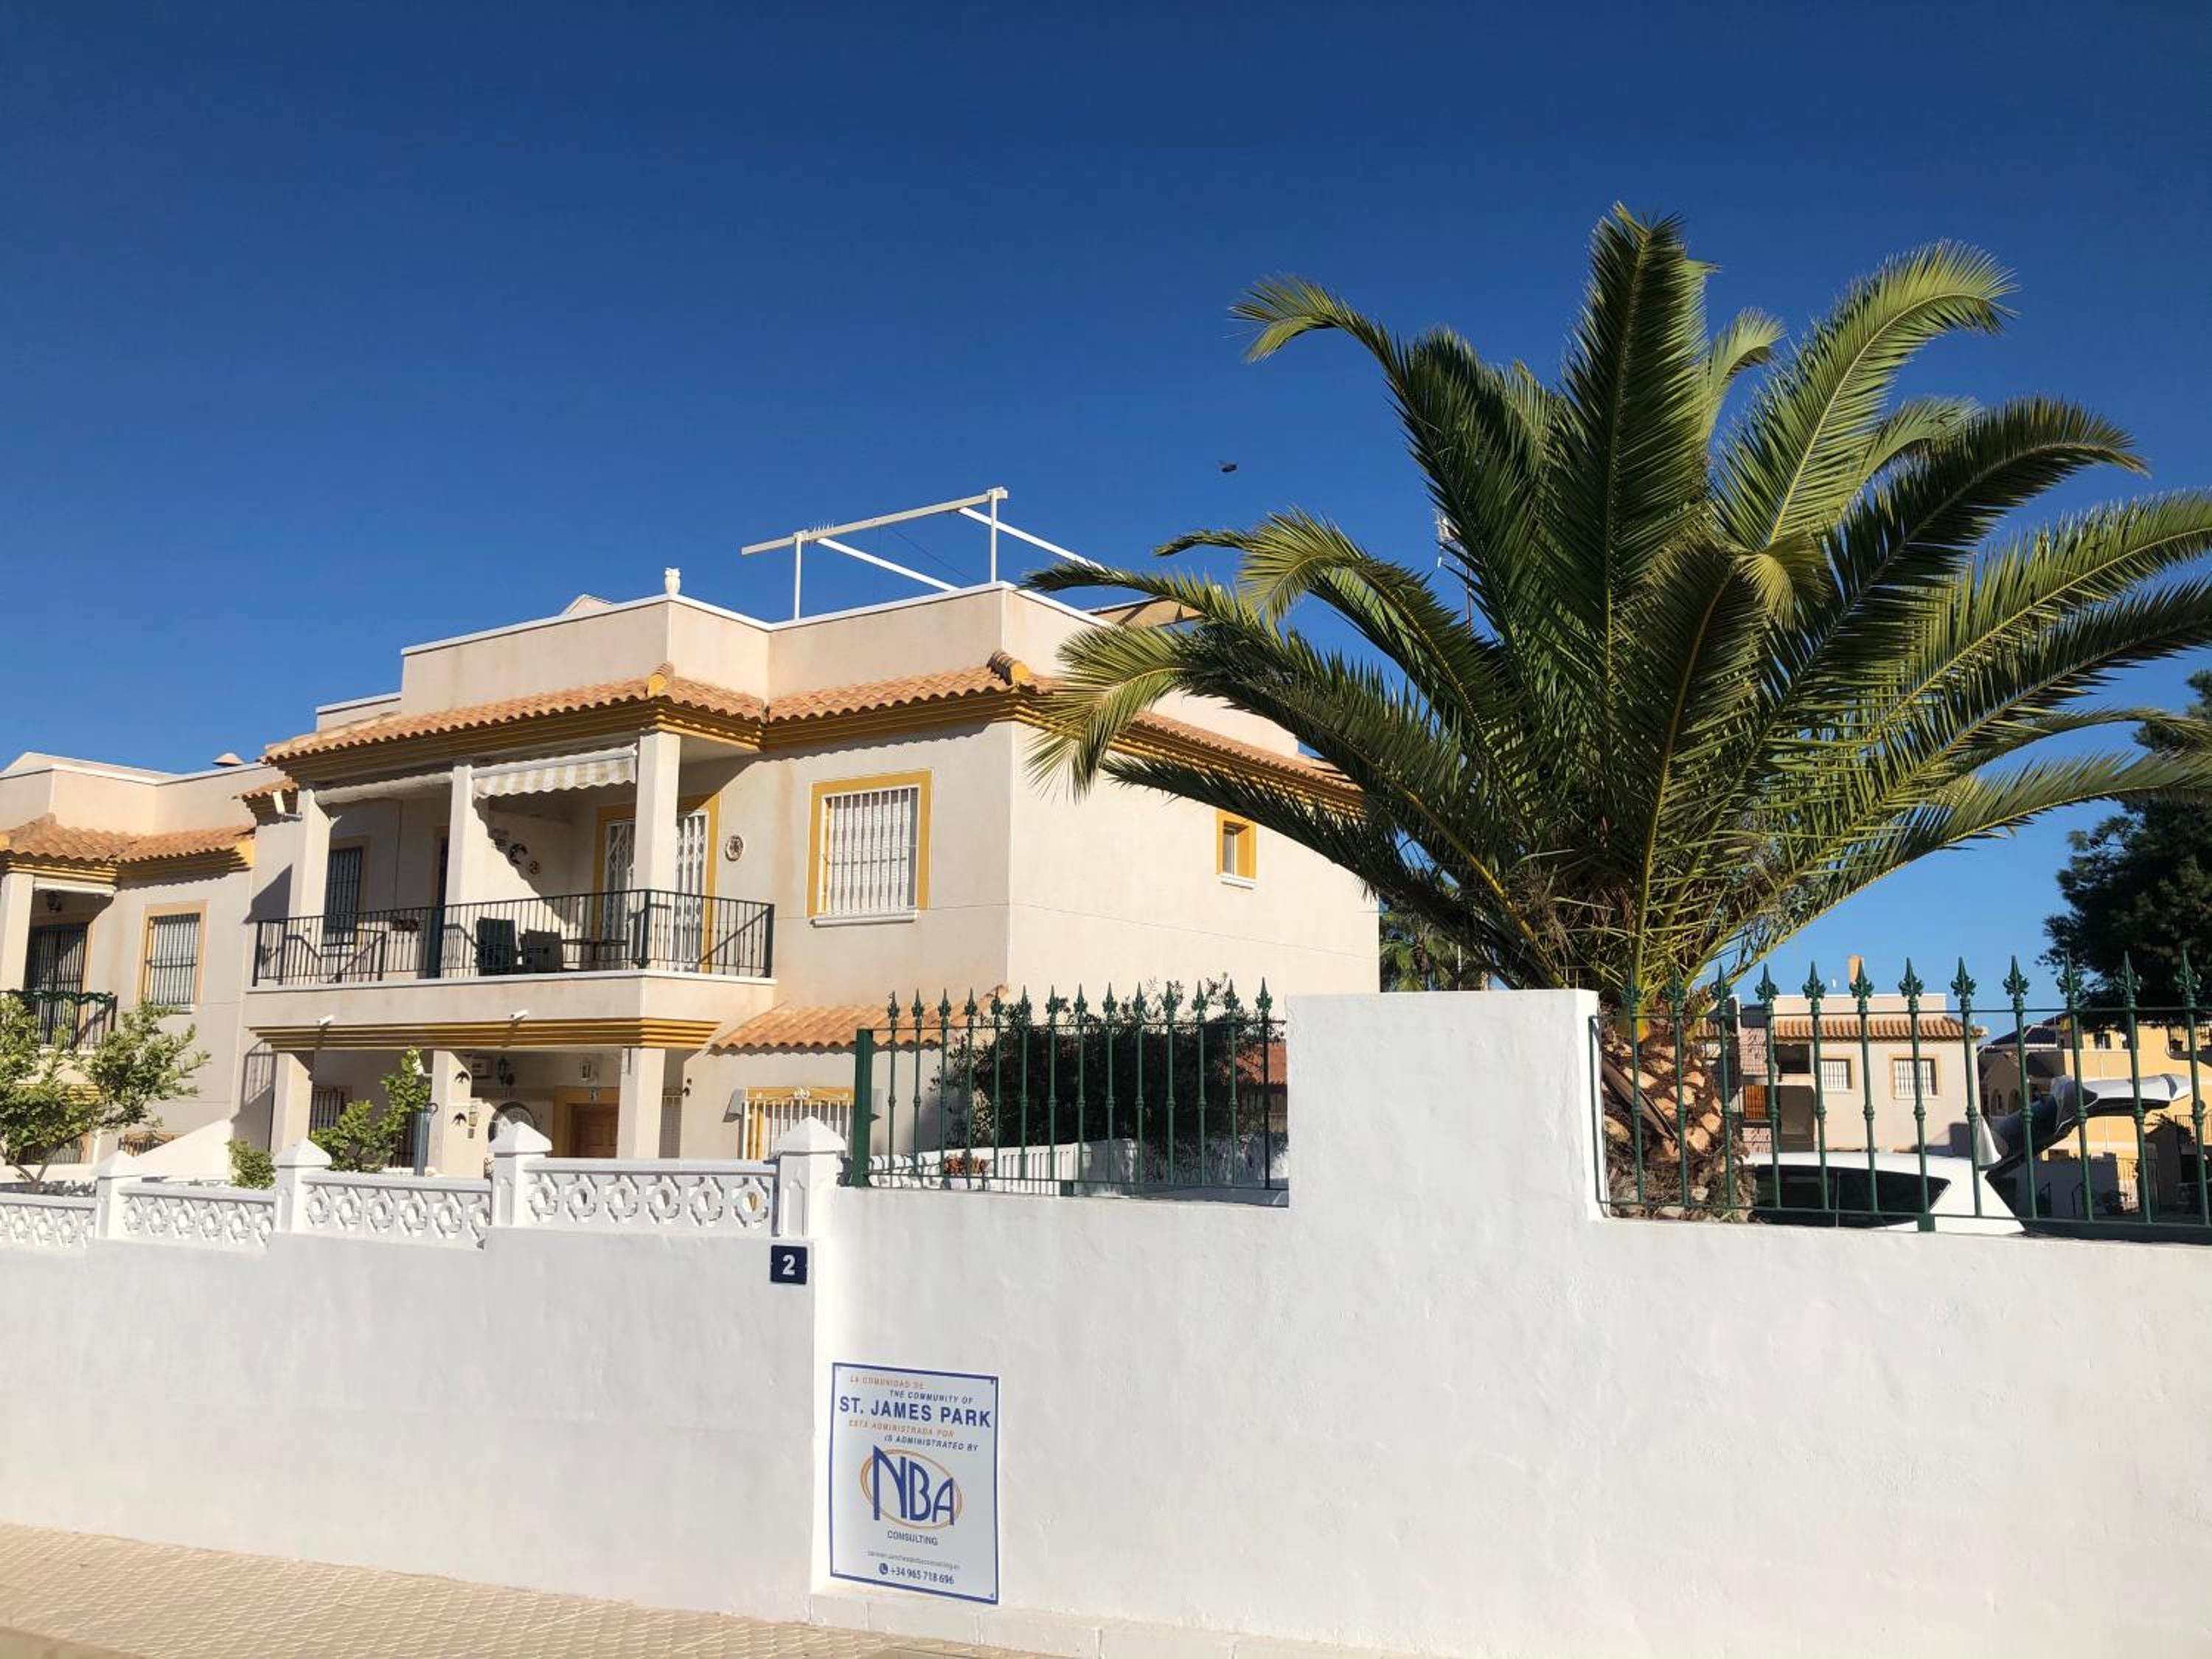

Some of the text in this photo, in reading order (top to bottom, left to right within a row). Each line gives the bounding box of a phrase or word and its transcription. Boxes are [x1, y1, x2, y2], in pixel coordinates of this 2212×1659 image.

[782, 1254, 796, 1275] 2
[862, 1377, 909, 1388] COMUNIDAD
[890, 1389, 973, 1405] THE COMMUNITY OF
[839, 1396, 992, 1428] ST. JAMES PARK
[872, 1423, 933, 1436] ADMINISTRADA
[936, 1429, 955, 1438] POR
[896, 1436, 964, 1450] ADMINISTRATED
[967, 1443, 978, 1452] BY
[873, 1444, 954, 1526] NBA
[887, 1530, 939, 1546] CONSULTING
[891, 1566, 955, 1585] +34 965 718 696
